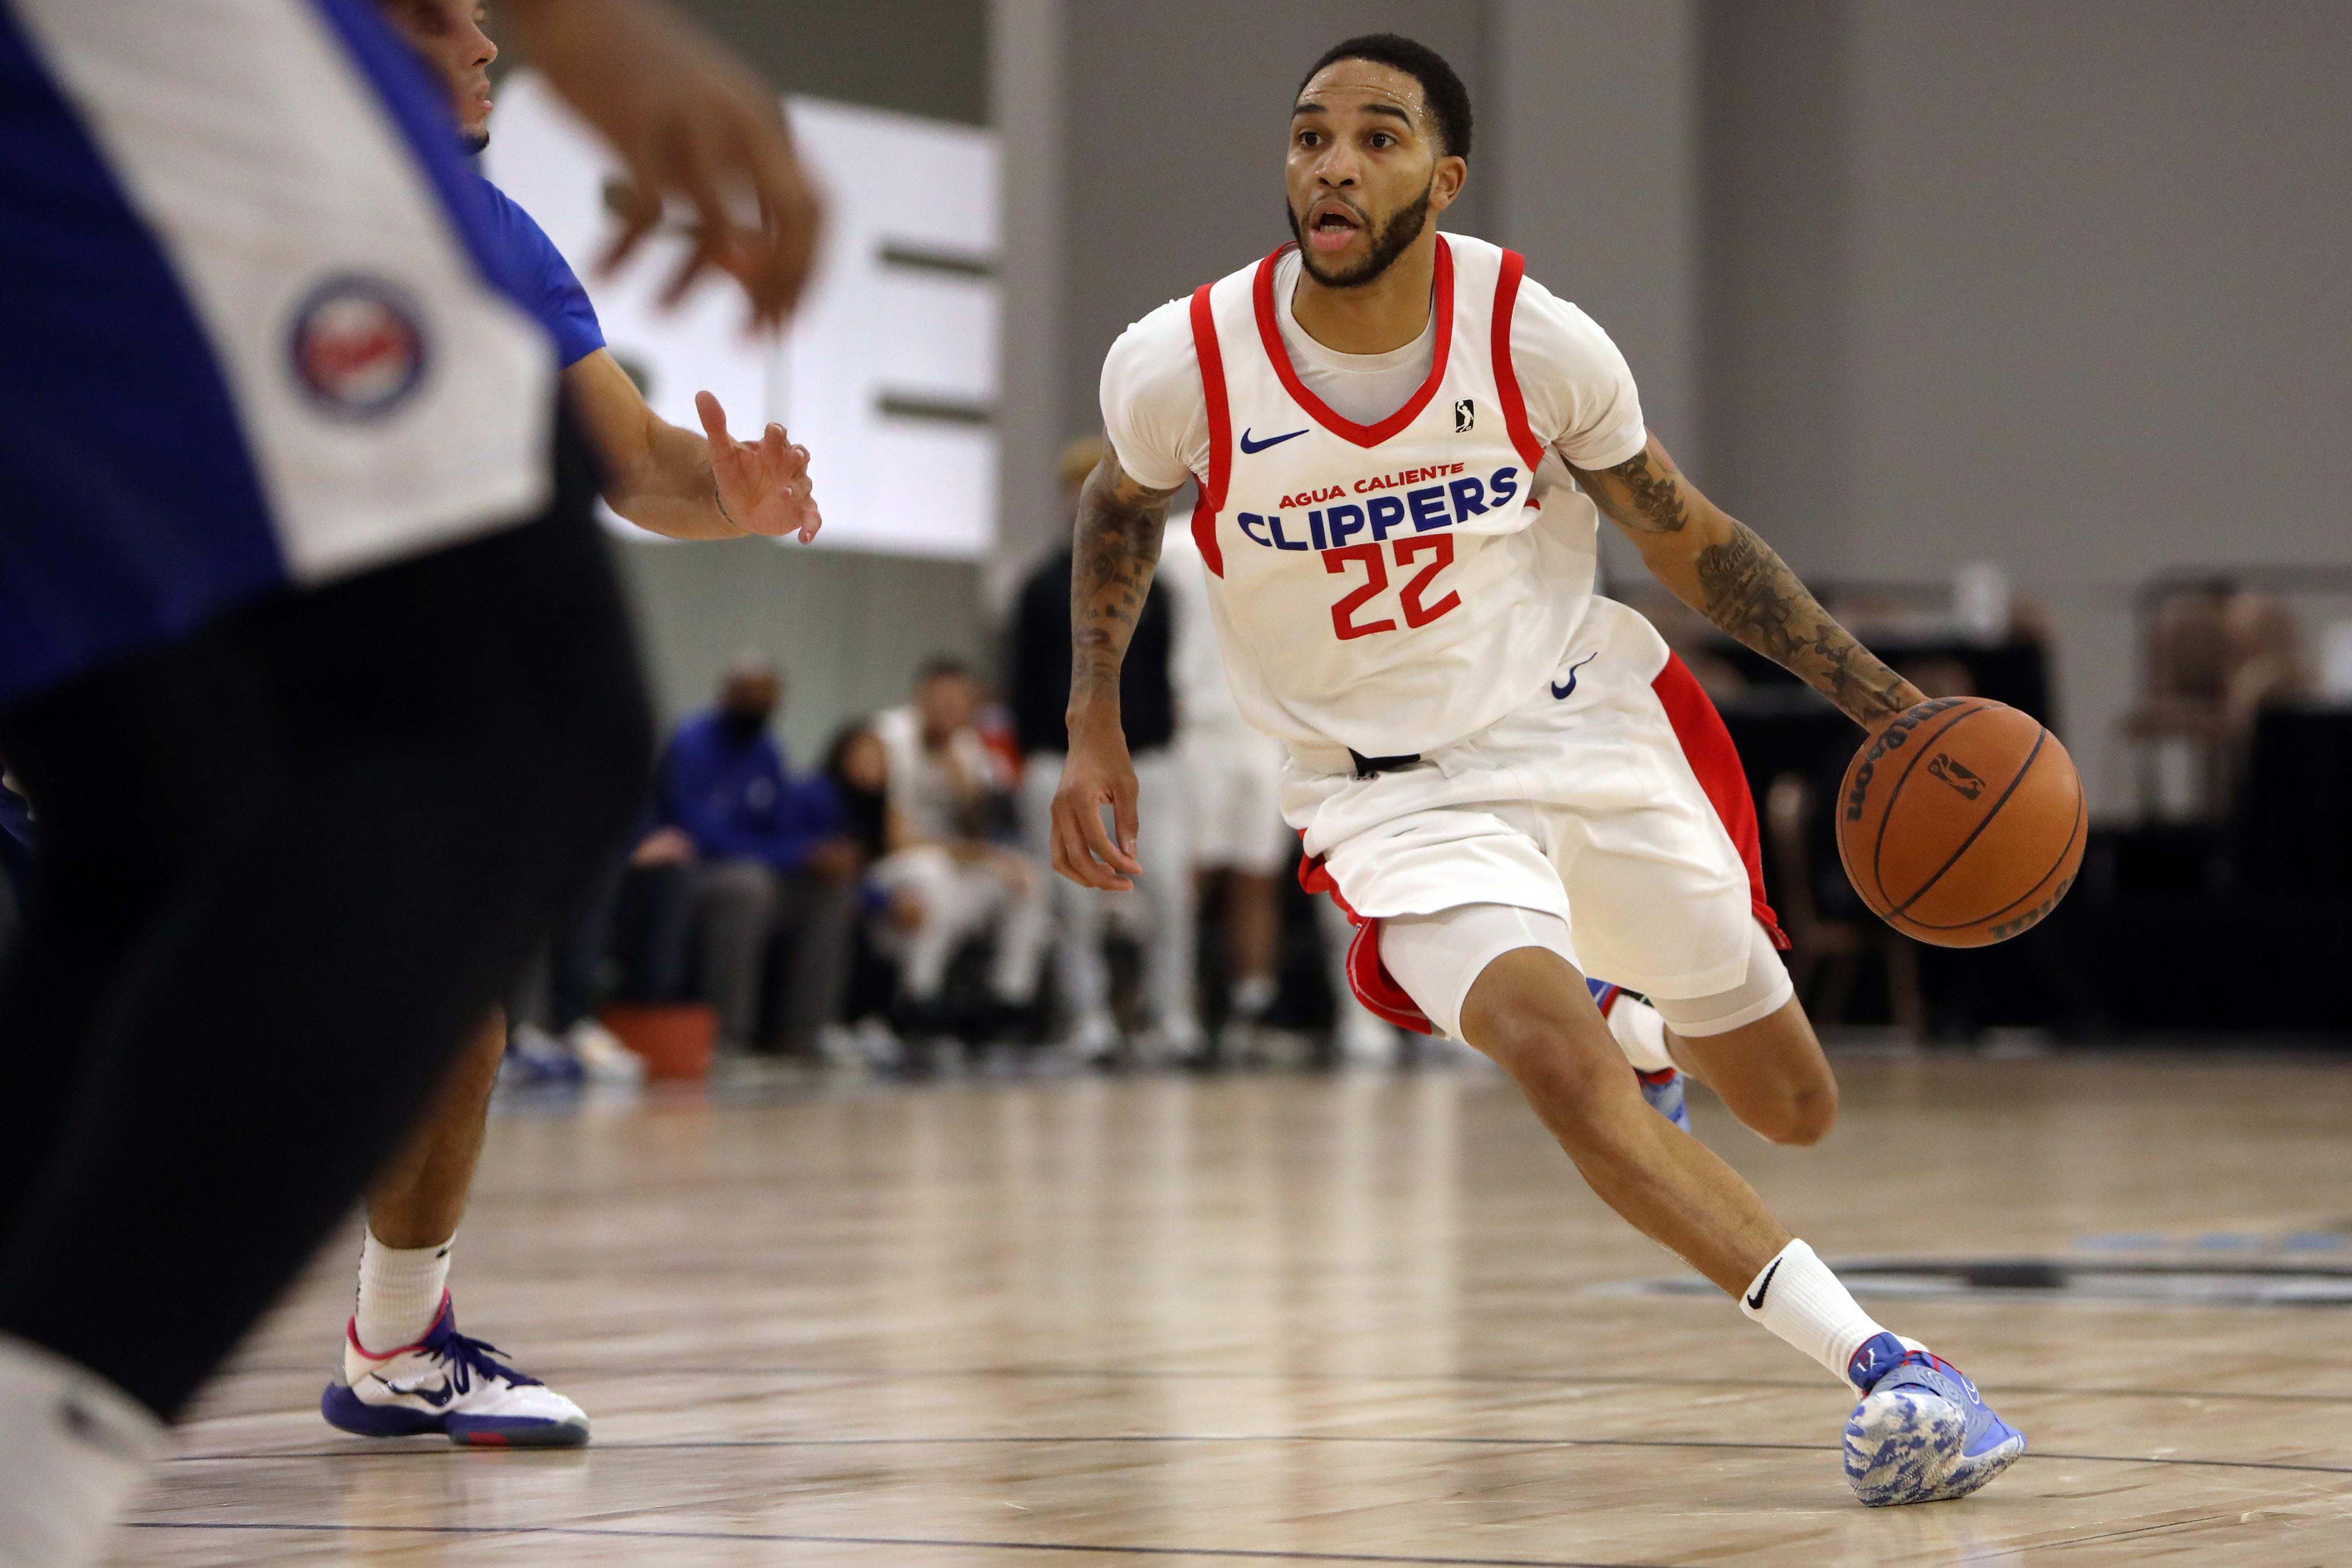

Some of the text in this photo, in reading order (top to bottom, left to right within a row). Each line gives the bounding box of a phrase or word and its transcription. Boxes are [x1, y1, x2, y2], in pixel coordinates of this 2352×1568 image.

[1237, 466, 1518, 551] CLIPPERS
[1279, 462, 1464, 509] AGUA CALIENTE
[1321, 533, 1462, 640] 22
